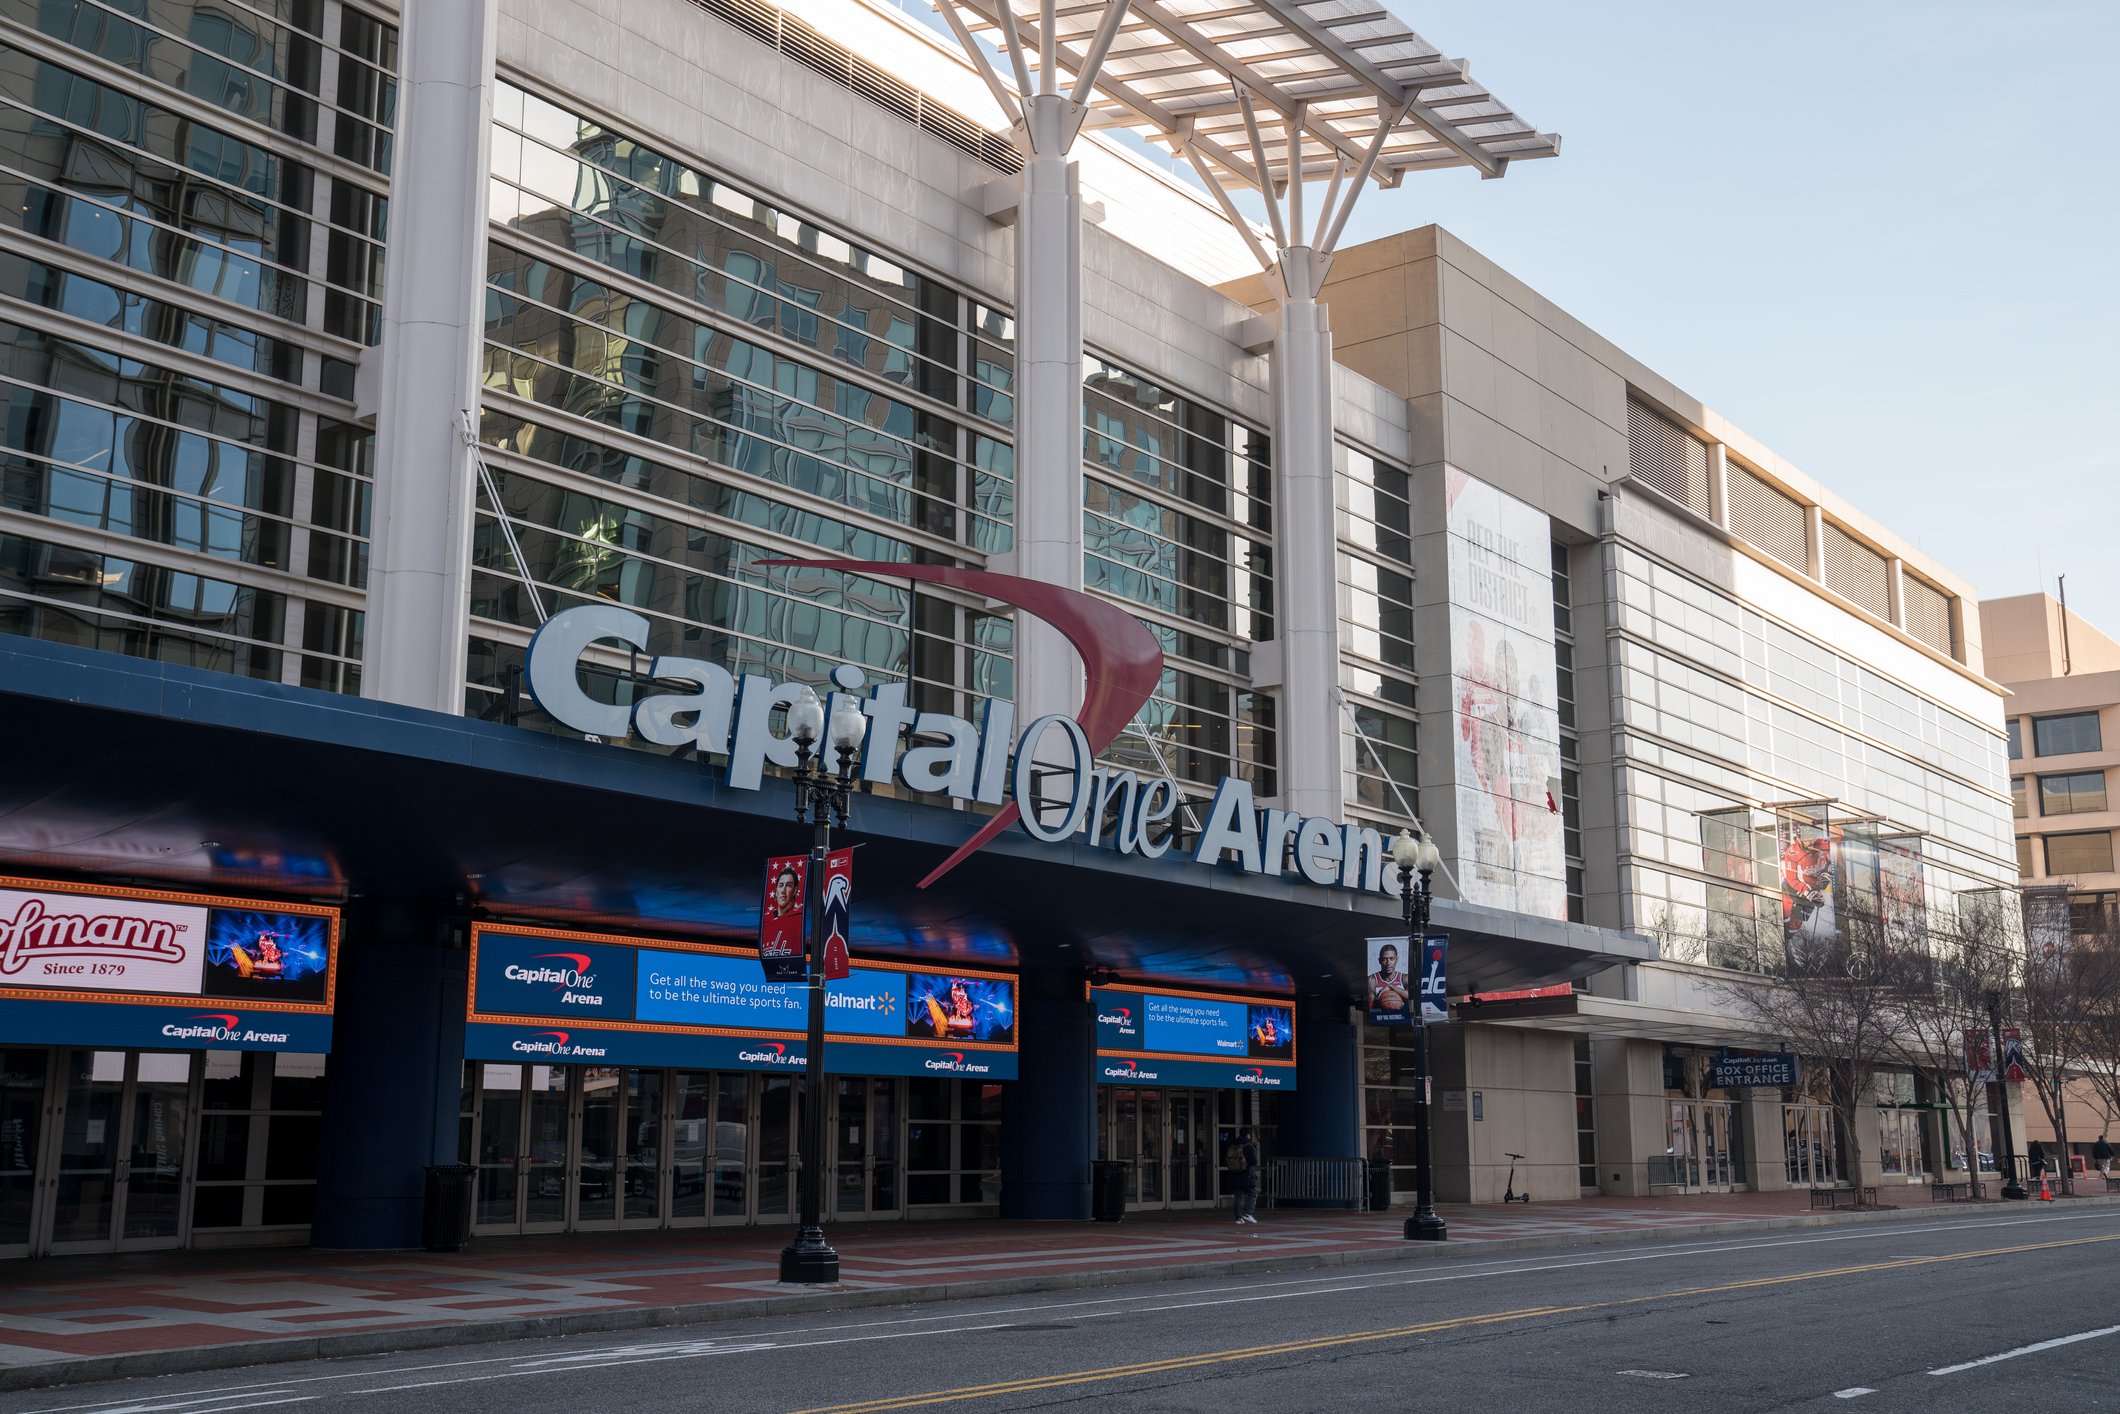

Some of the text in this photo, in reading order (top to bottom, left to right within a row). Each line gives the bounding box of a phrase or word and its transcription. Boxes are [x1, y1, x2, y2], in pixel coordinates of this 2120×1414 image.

[0, 898, 186, 975] ofmann
[43, 963, 126, 976] Since 1879
[650, 973, 786, 995] Get all the swag you need
[561, 991, 603, 1005] Arena
[649, 988, 802, 1010] to be the ultimate sports fan.
[1148, 1002, 1160, 1012] Get
[1169, 1005, 1178, 1013] the
[1179, 1008, 1194, 1017] swag
[1194, 1009, 1205, 1018] you
[1205, 1008, 1220, 1017] need
[1156, 1014, 1164, 1022] be
[1165, 1015, 1175, 1023] the
[1176, 1016, 1199, 1025] ultimate
[1200, 1018, 1217, 1028] sports
[243, 1030, 288, 1043] Arena
[1216, 1039, 1237, 1048] Walmart
[572, 1045, 606, 1056] Arena
[788, 1055, 807, 1065] Are
[966, 1063, 989, 1073] Arena
[1716, 1064, 1789, 1076] BOX OFFICE
[1138, 1071, 1157, 1080] Arena
[1264, 1077, 1281, 1085] Arena
[1717, 1073, 1790, 1086] ENTRANCE
